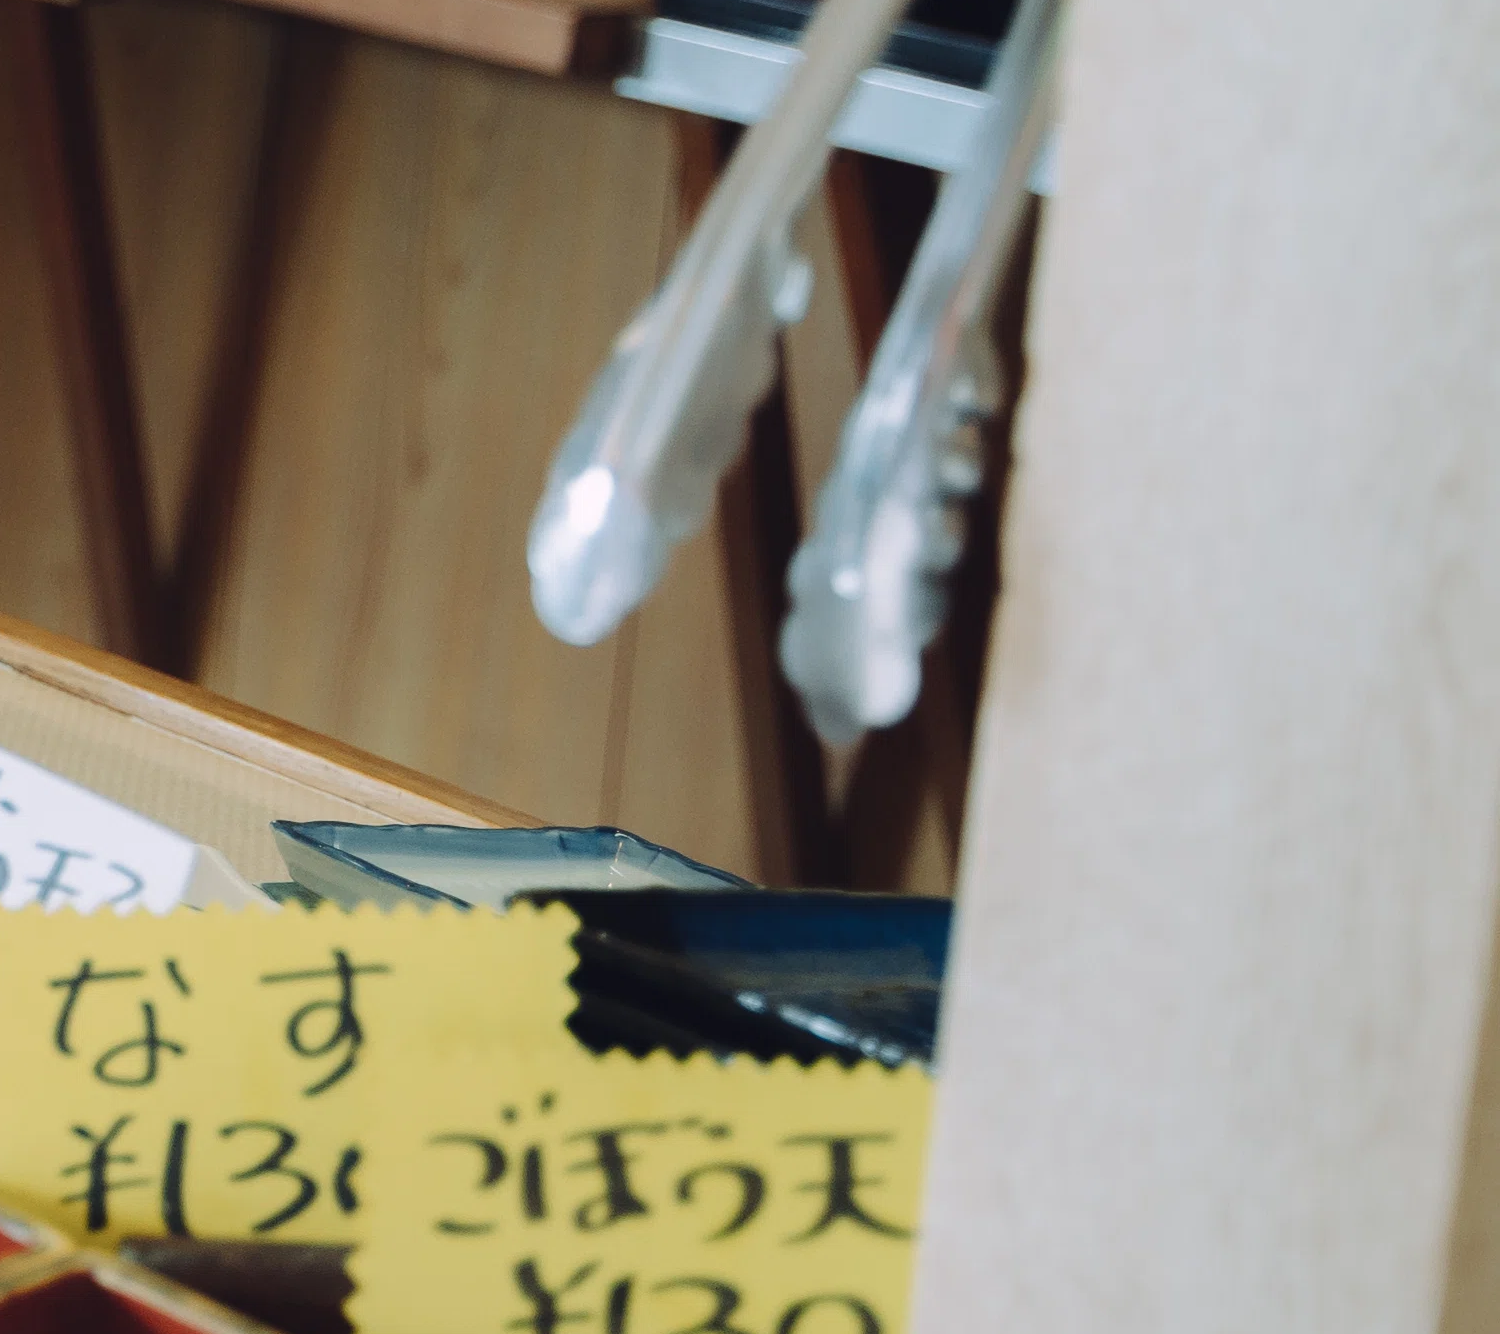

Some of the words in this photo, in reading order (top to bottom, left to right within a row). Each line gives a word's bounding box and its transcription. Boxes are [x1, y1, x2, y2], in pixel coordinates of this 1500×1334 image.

[48, 946, 392, 1097] なす
[425, 1092, 920, 1244] ごぼう天
